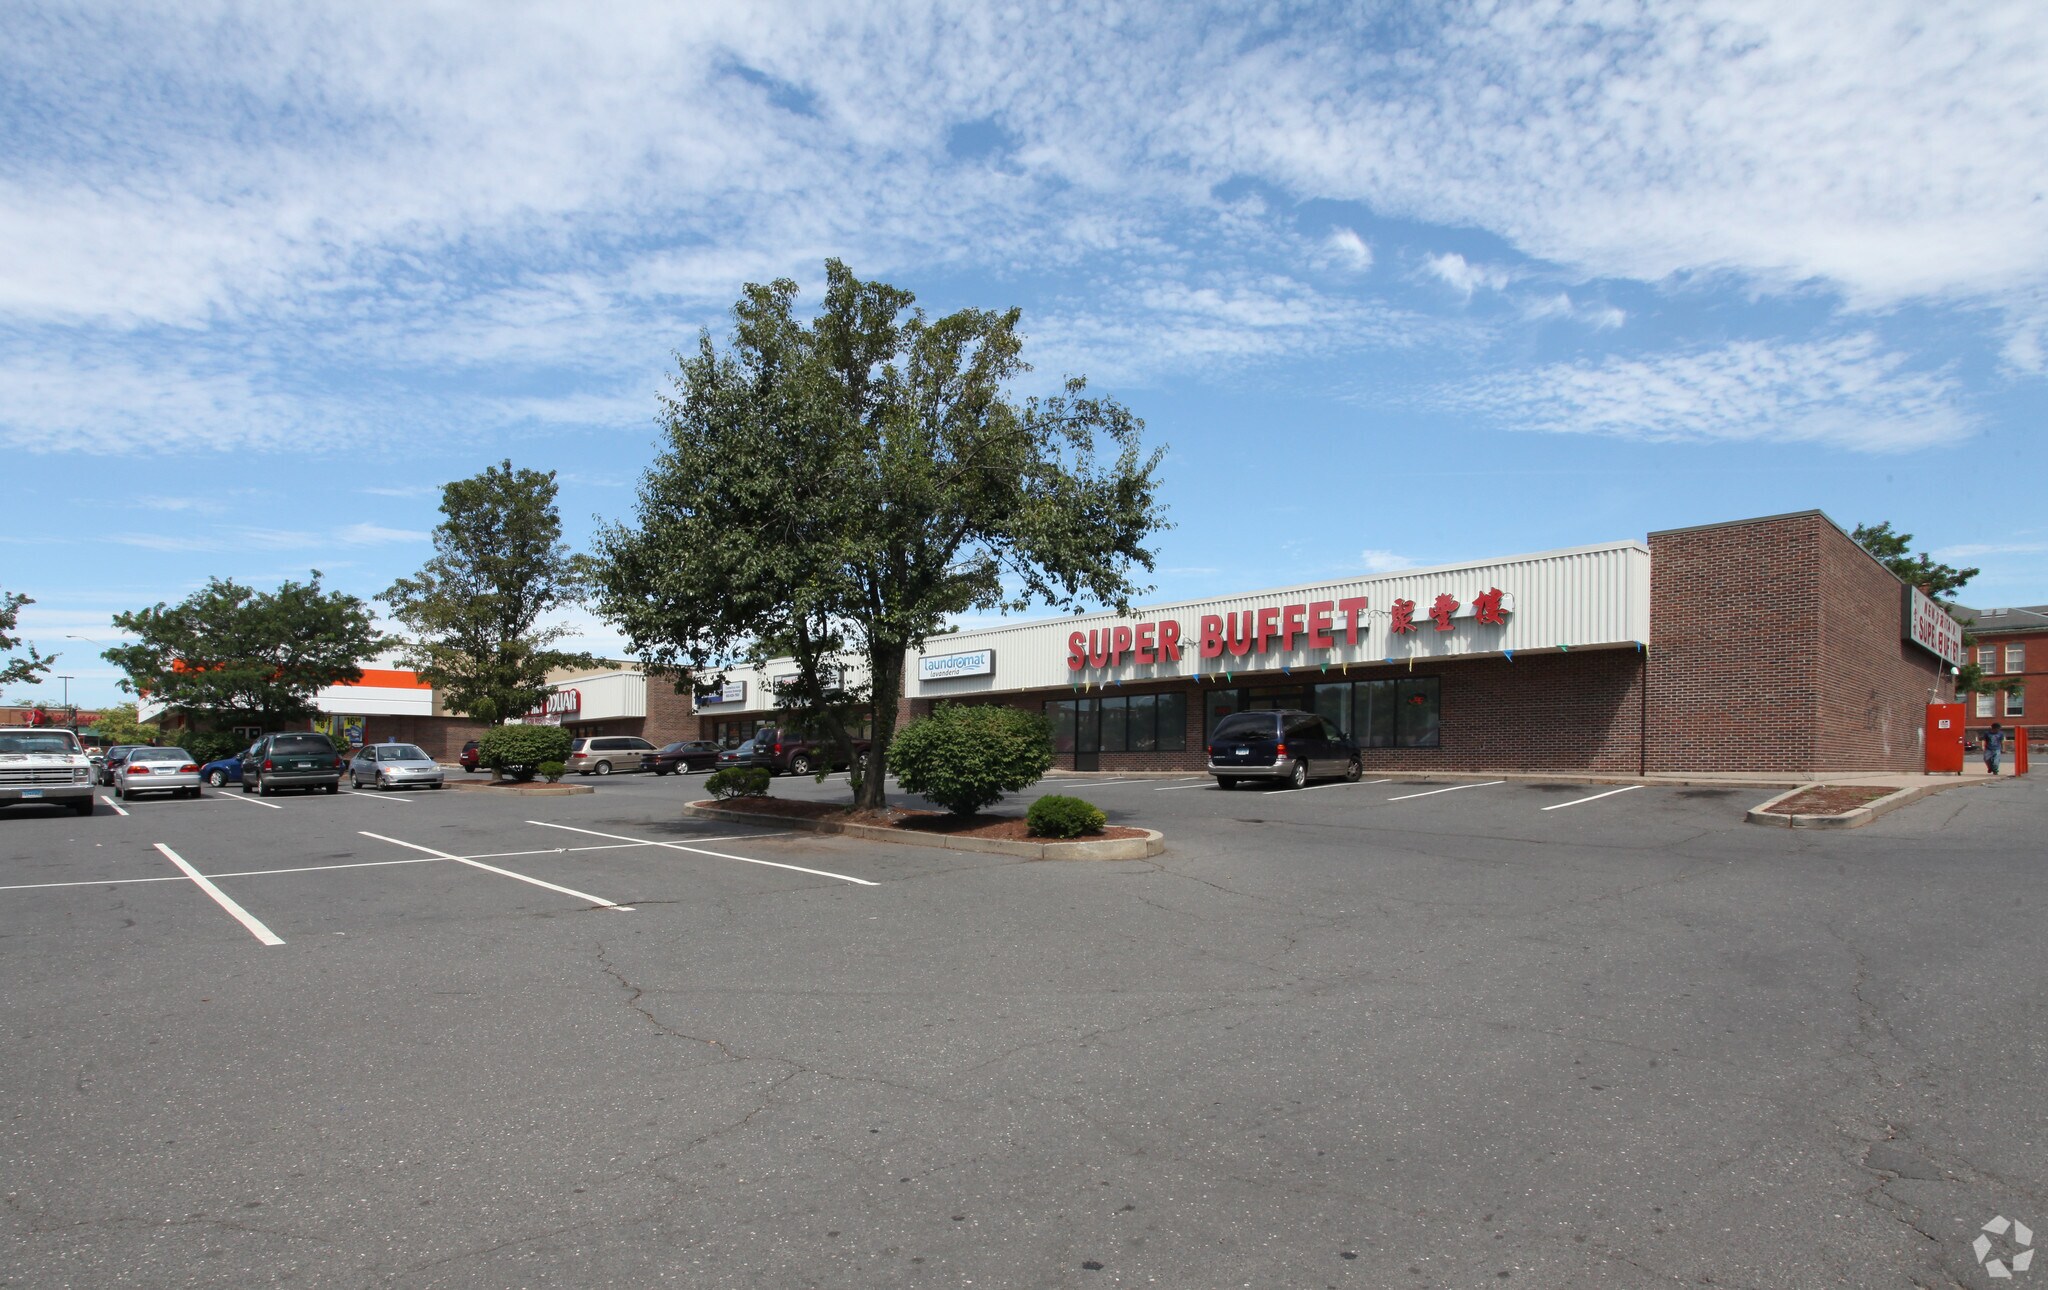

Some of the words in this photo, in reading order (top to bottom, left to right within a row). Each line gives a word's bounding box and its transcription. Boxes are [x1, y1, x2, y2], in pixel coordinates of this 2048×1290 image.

[1067, 619, 1182, 672] SUPER
[1200, 596, 1368, 659] BUFFET
[1918, 615, 1937, 650] SUPE
[924, 653, 985, 671] laundromat
[930, 668, 960, 678] lavanderia
